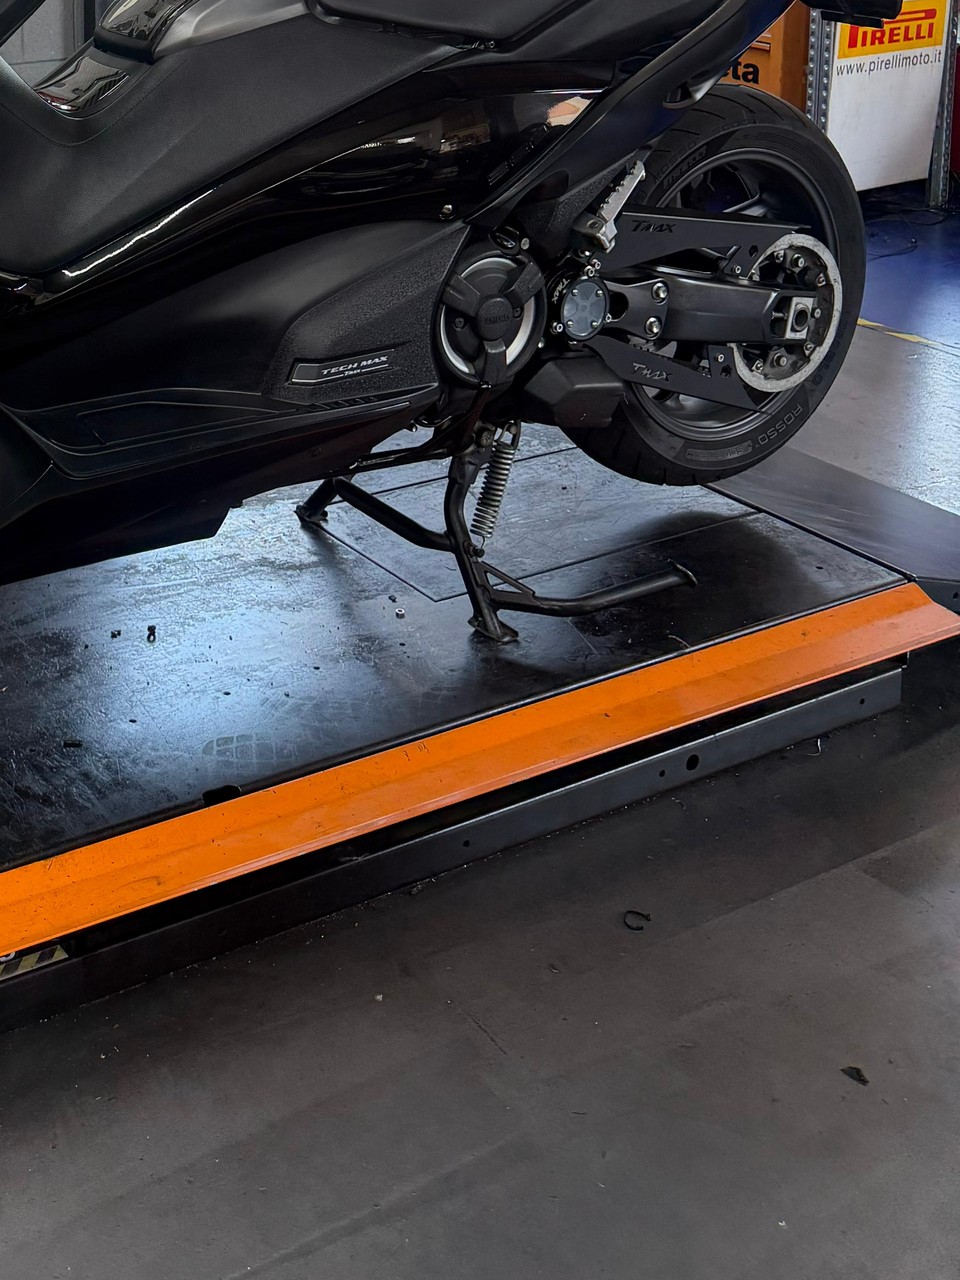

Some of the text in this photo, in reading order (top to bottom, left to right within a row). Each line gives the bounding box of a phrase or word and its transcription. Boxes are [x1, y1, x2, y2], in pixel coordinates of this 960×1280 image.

[847, 8, 937, 49] PIRELLI
[835, 49, 942, 76] www.pirellimoto.it
[631, 219, 677, 233] TMAX
[321, 355, 389, 376] TECH MAX
[631, 361, 673, 383] TMAX
[757, 403, 803, 446] ROSSO
